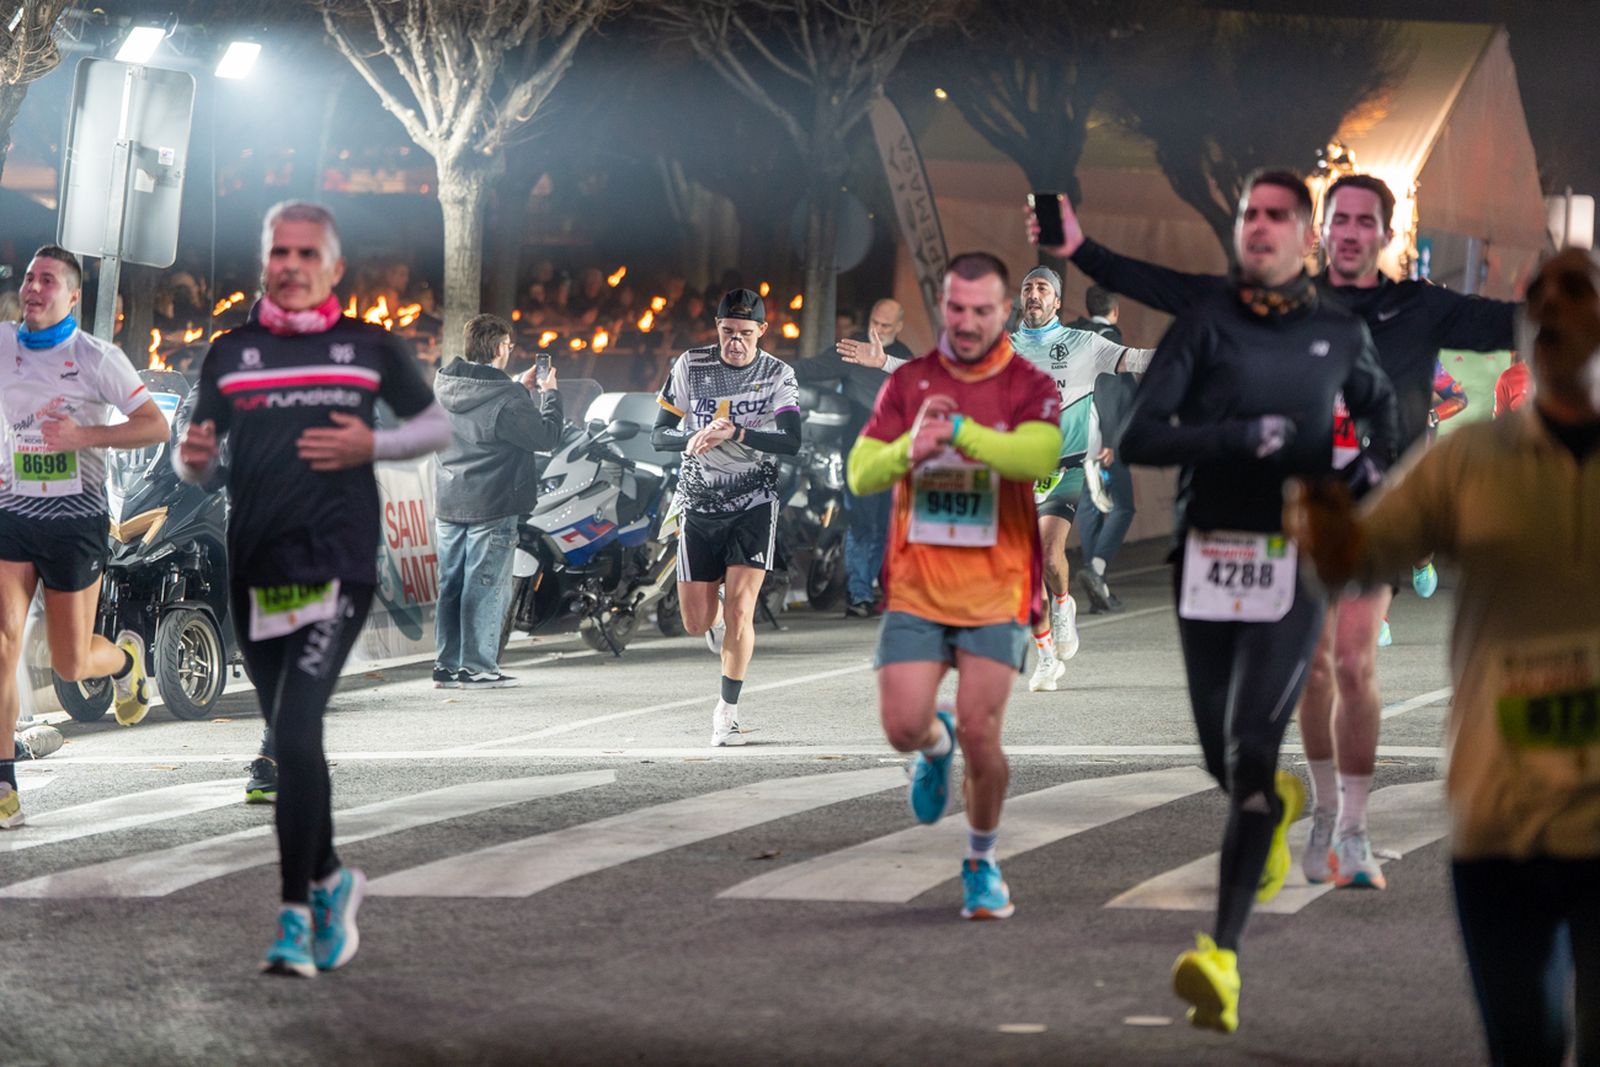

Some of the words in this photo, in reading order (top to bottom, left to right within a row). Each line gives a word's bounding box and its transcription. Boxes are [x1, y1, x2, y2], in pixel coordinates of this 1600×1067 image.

[22, 453, 68, 474] 8698
[927, 491, 982, 518] 9497
[385, 499, 428, 550] SAN
[1207, 561, 1274, 588] 4288
